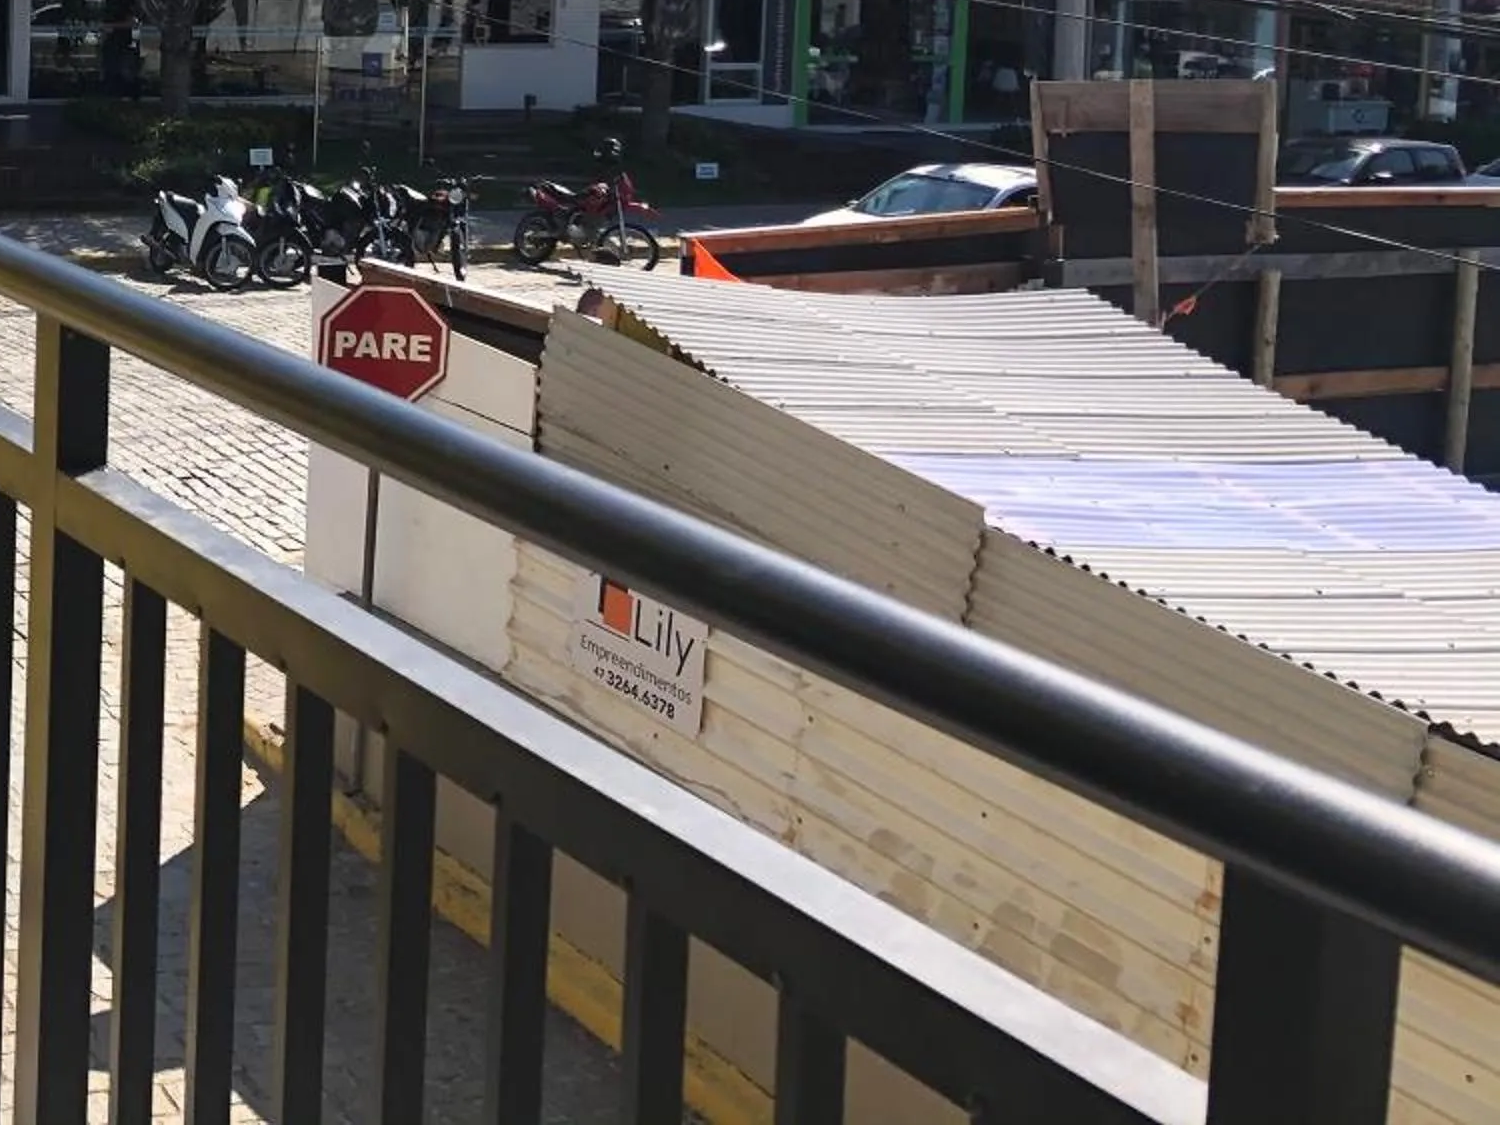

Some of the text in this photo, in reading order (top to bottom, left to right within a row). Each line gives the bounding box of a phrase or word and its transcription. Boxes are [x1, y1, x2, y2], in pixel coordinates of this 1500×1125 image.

[333, 330, 433, 363] PARE
[635, 598, 695, 677] Lily
[580, 634, 693, 706] Empreendimentos
[605, 670, 676, 720] 3264.6378
